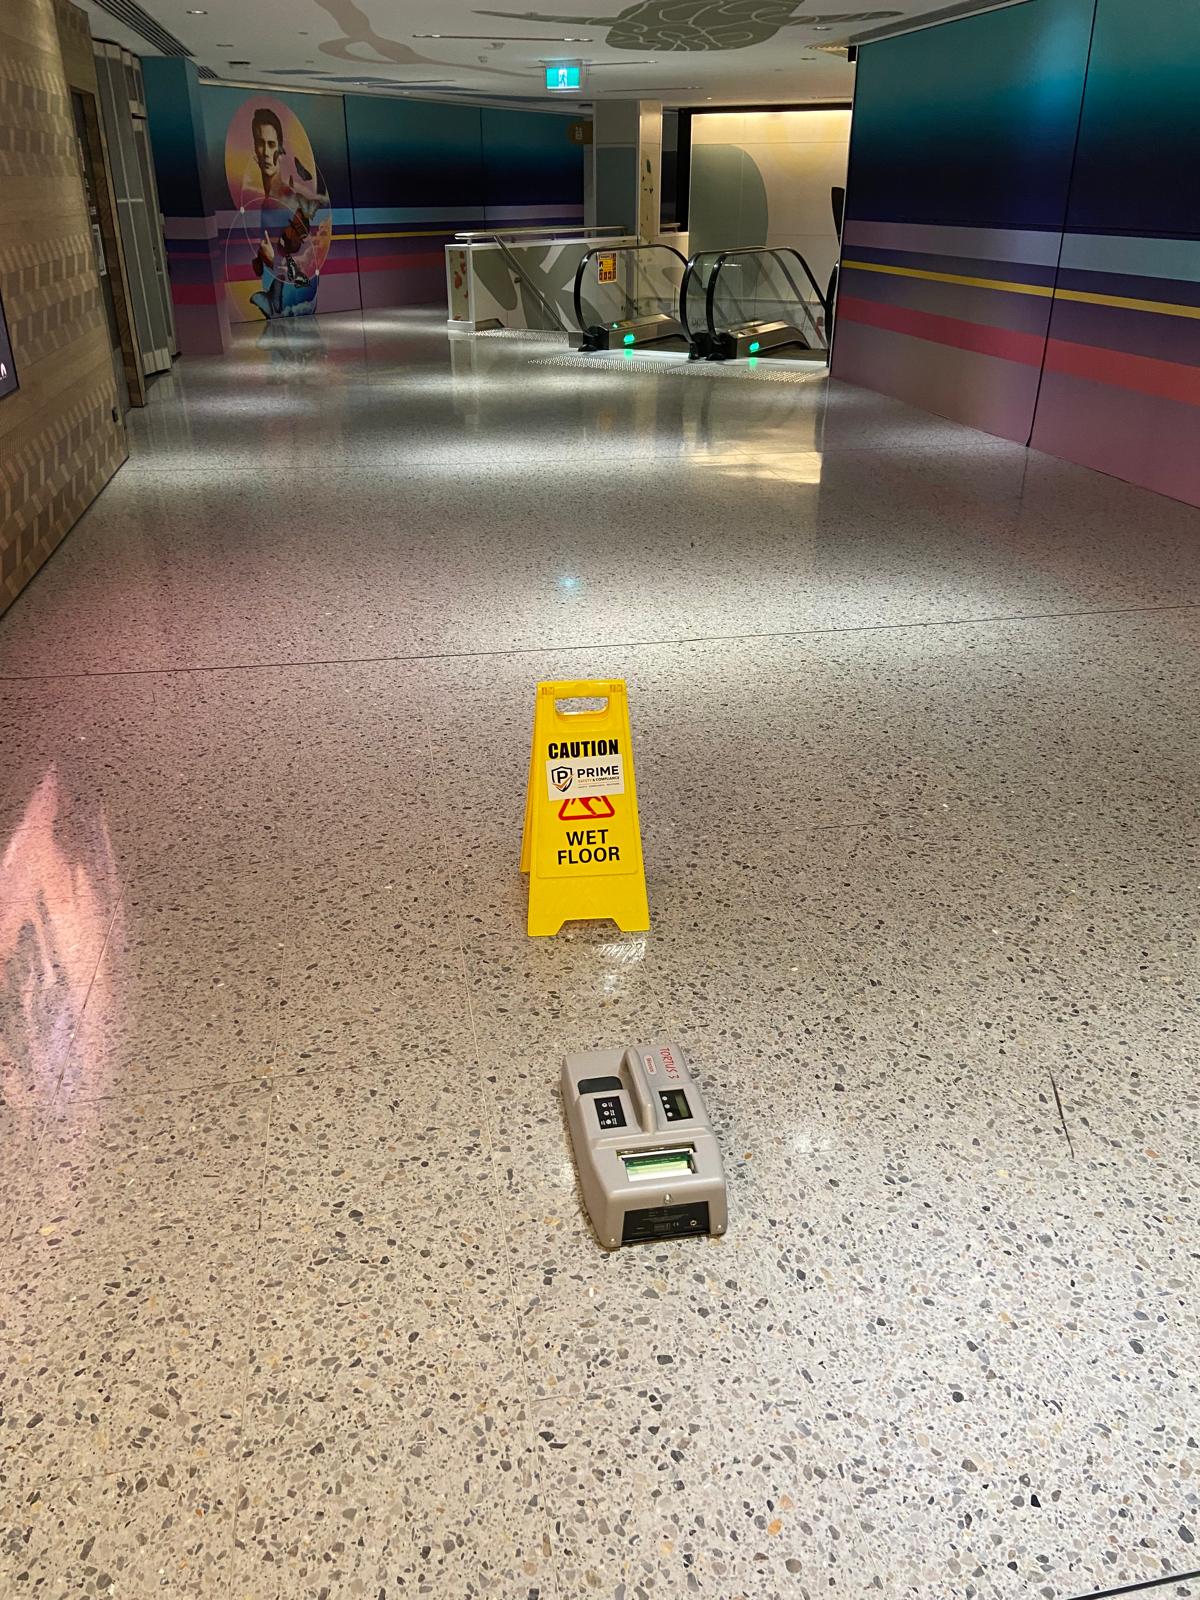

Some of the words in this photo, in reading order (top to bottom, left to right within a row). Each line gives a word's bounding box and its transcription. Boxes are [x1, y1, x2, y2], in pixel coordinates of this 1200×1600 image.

[548, 739, 619, 760] CAUTION
[577, 765, 619, 778] PRIME
[566, 829, 608, 846] WET
[558, 847, 620, 865] FLOOR
[659, 1047, 678, 1073] TORTUS
